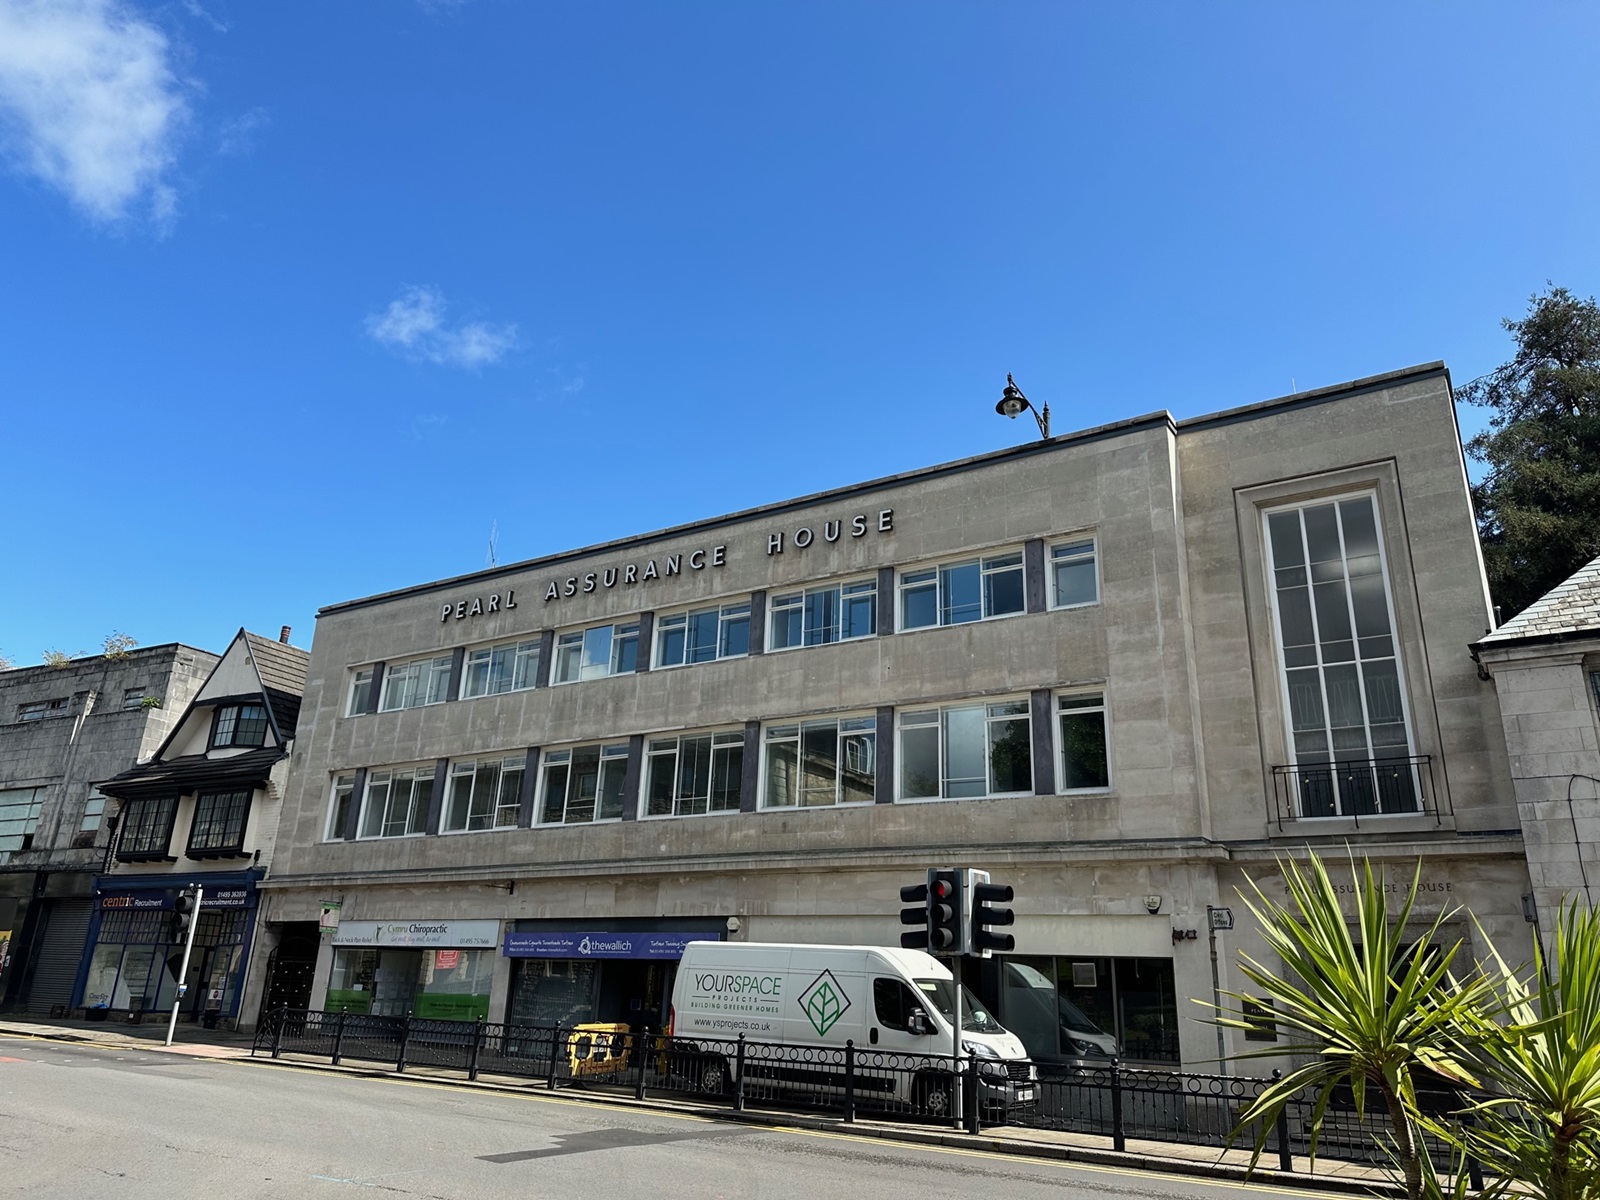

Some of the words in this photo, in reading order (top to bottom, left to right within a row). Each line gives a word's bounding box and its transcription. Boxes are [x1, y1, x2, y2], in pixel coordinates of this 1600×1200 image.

[441, 590, 517, 622] PEARL
[544, 545, 727, 601] ASSURANCE
[766, 509, 894, 555] HOUSE
[1406, 882, 1453, 894] HOUSE
[102, 893, 135, 908] centric
[134, 899, 163, 907] Recruitment
[387, 924, 408, 935] Cymru
[408, 923, 448, 936] Chiropractic
[591, 940, 632, 951] thewallich
[695, 973, 782, 995] YOURSPACE
[712, 995, 758, 1003] PROJECTS
[723, 1003, 753, 1011] GREENER
[694, 1018, 771, 1031] www.ysprojects.co.uk
